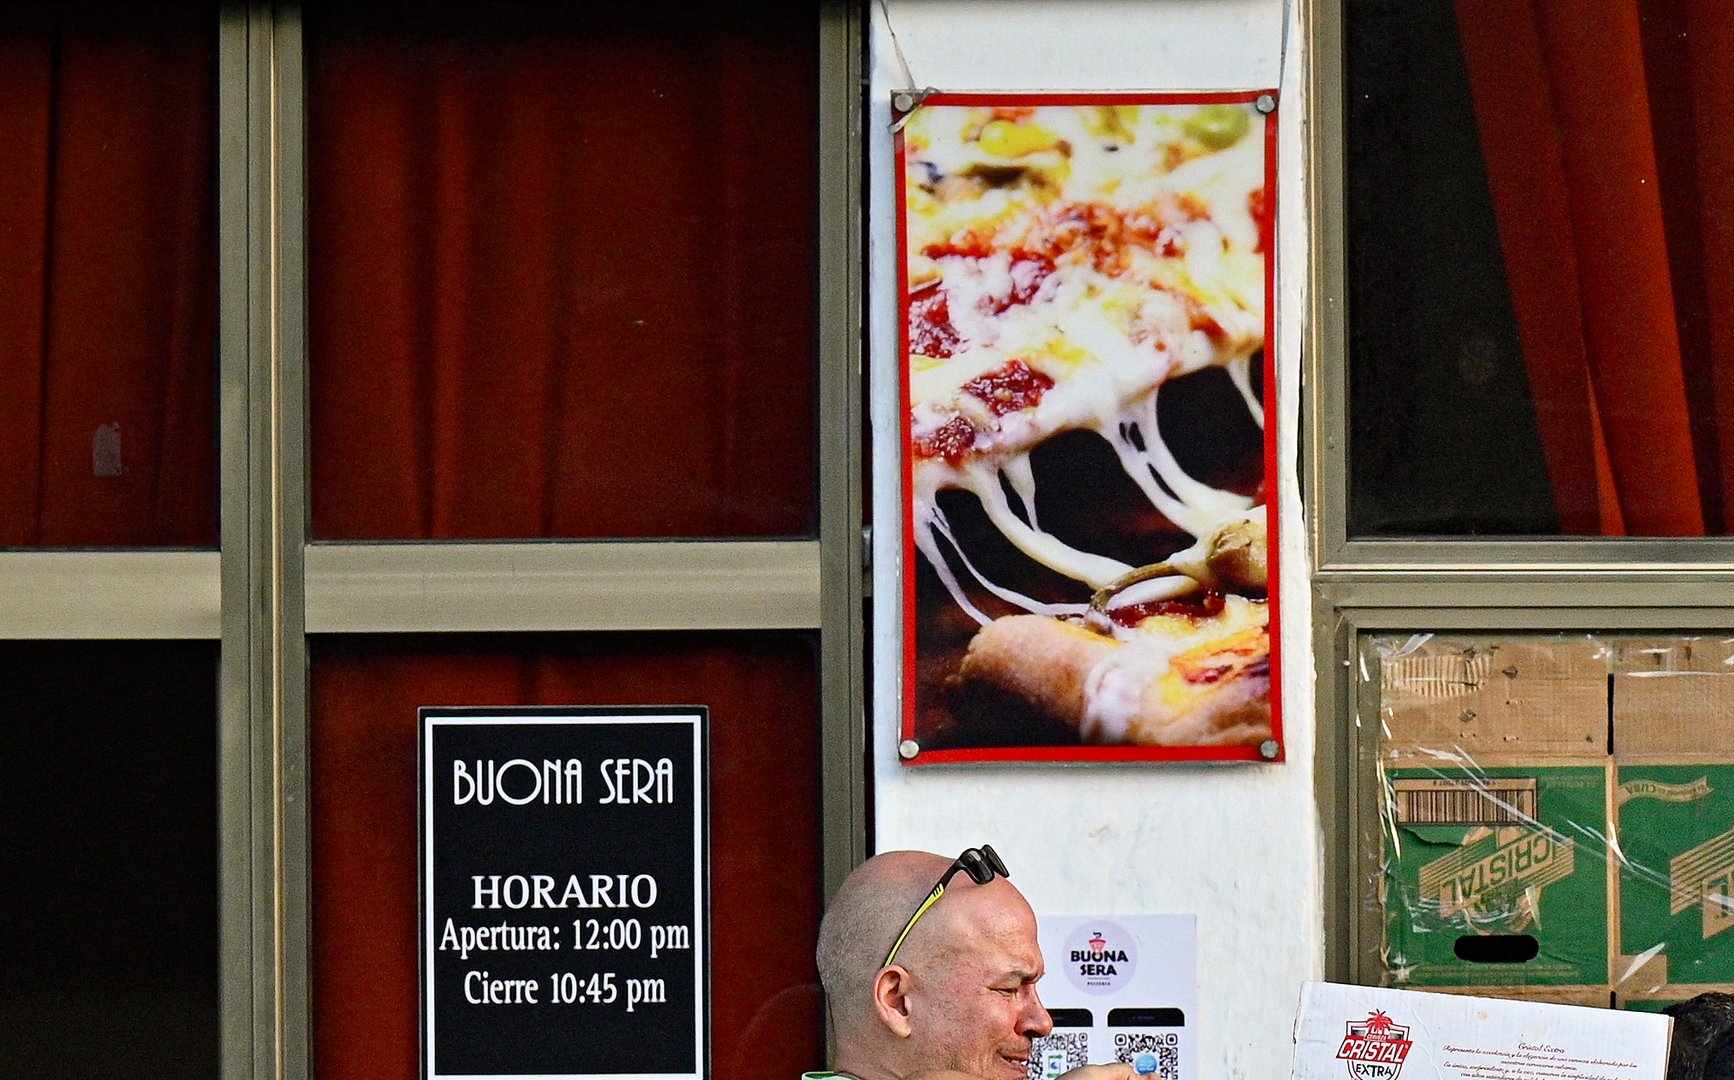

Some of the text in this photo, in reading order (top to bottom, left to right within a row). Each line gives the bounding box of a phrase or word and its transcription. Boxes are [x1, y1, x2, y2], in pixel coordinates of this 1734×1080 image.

[453, 758, 674, 806] BUONA SERA
[1442, 837, 1551, 906] CRISTAL
[472, 874, 658, 909] HORARIO
[439, 917, 690, 960] Apertura: 12:00 pm
[1070, 950, 1129, 963] BUONA
[1080, 964, 1118, 976] SERA
[464, 970, 666, 1012] Cierre 10:45 pm
[1338, 1039, 1403, 1064] CRISTAL
[1518, 1042, 1565, 1054] Cristal Extra
[1356, 1064, 1394, 1078] EXTRA
